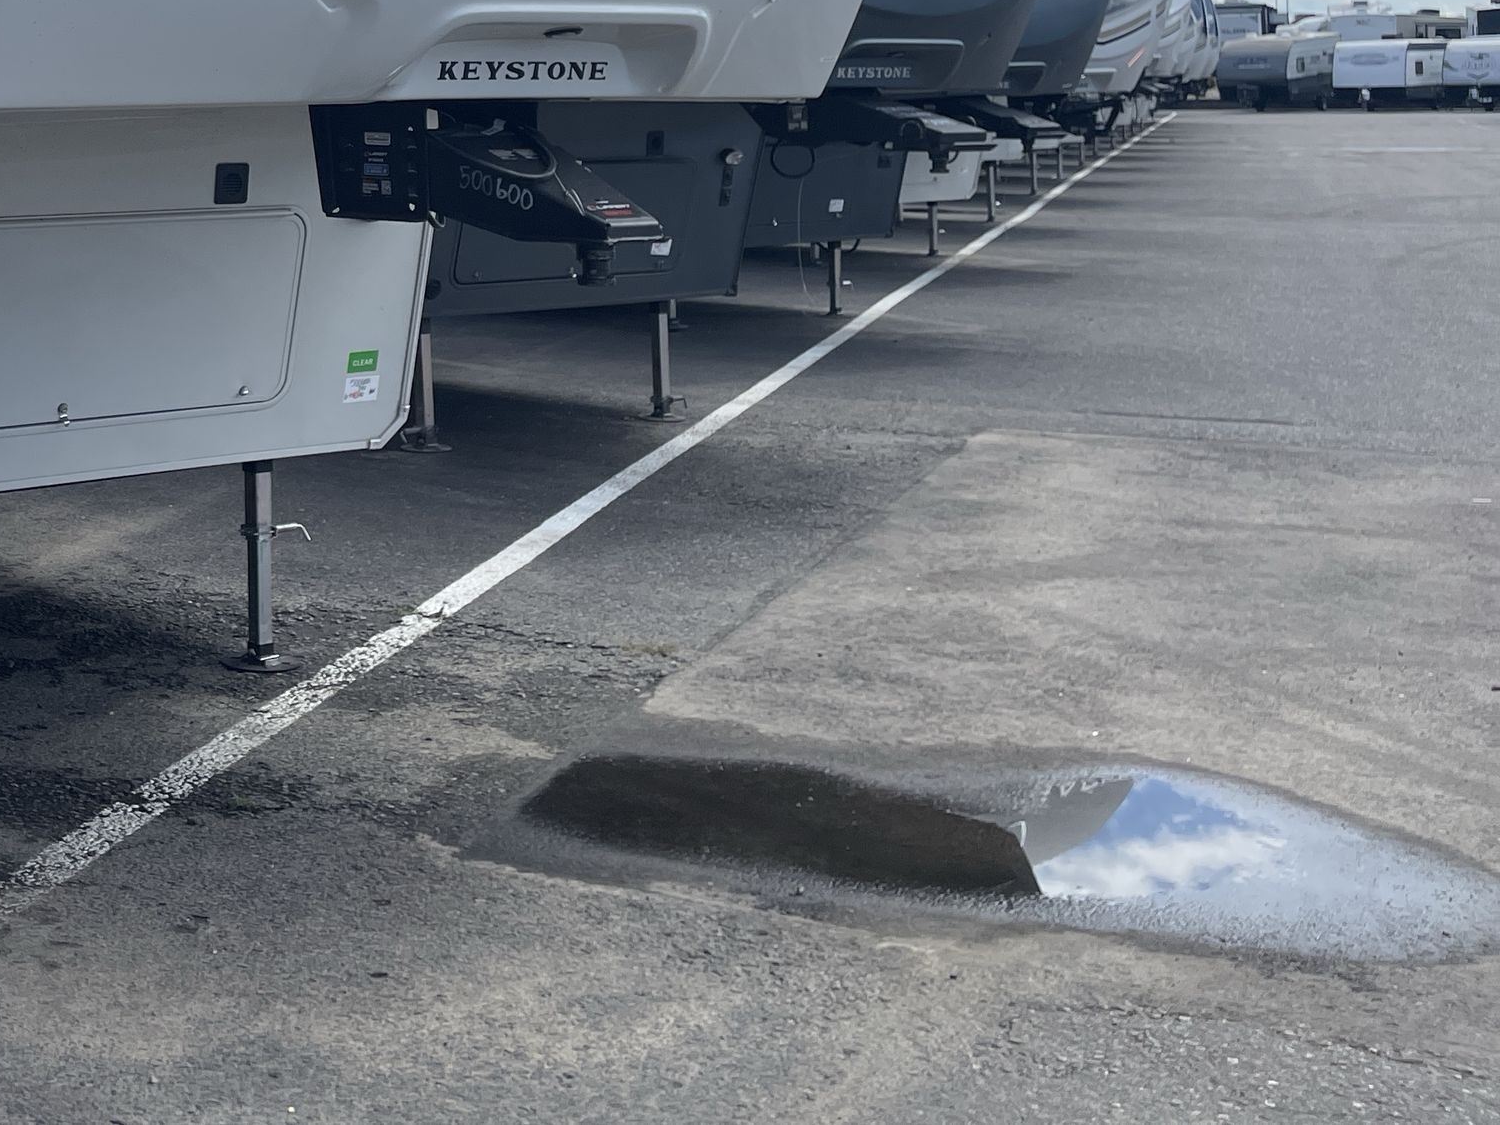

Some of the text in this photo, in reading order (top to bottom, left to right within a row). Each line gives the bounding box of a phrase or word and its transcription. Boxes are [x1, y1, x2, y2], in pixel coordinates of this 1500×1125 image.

[437, 61, 608, 81] KEYSTONE
[836, 66, 912, 79] KEYSTONE
[352, 358, 374, 367] CLEAR
